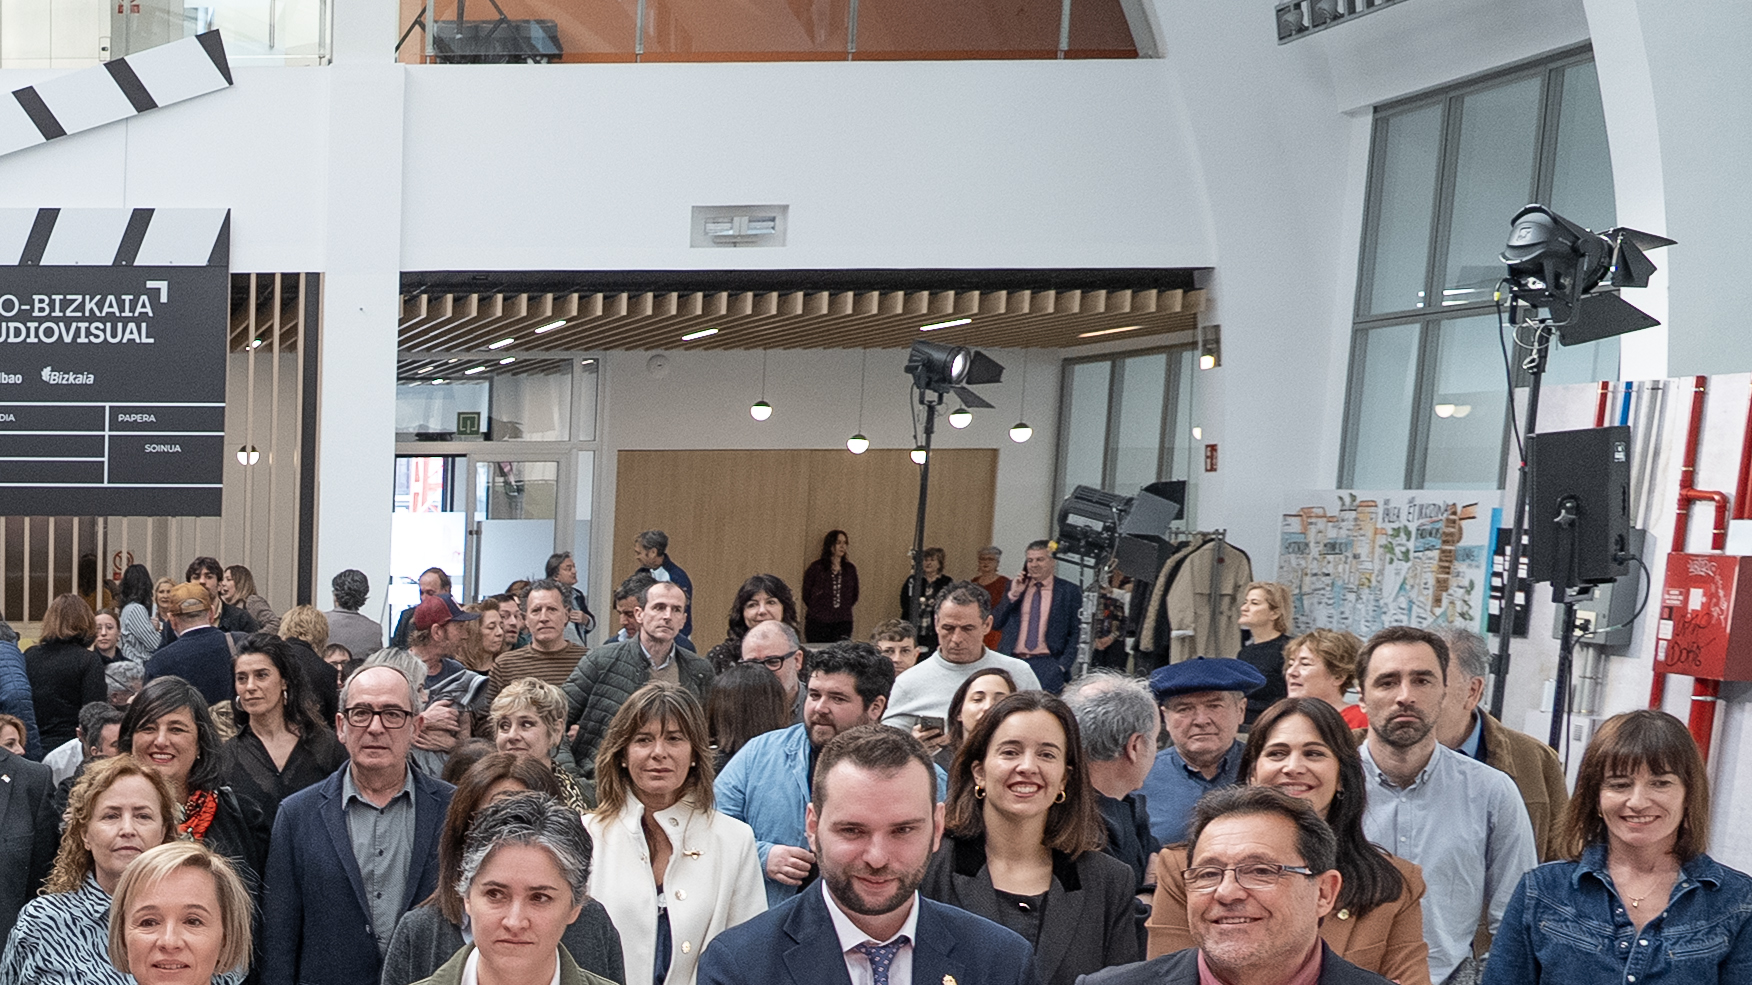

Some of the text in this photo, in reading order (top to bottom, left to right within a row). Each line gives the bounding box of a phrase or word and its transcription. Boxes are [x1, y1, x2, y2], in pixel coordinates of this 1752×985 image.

[49, 371, 95, 384] Bizkaia
[117, 413, 157, 423] PAPERA
[144, 443, 182, 453] SOINUA
